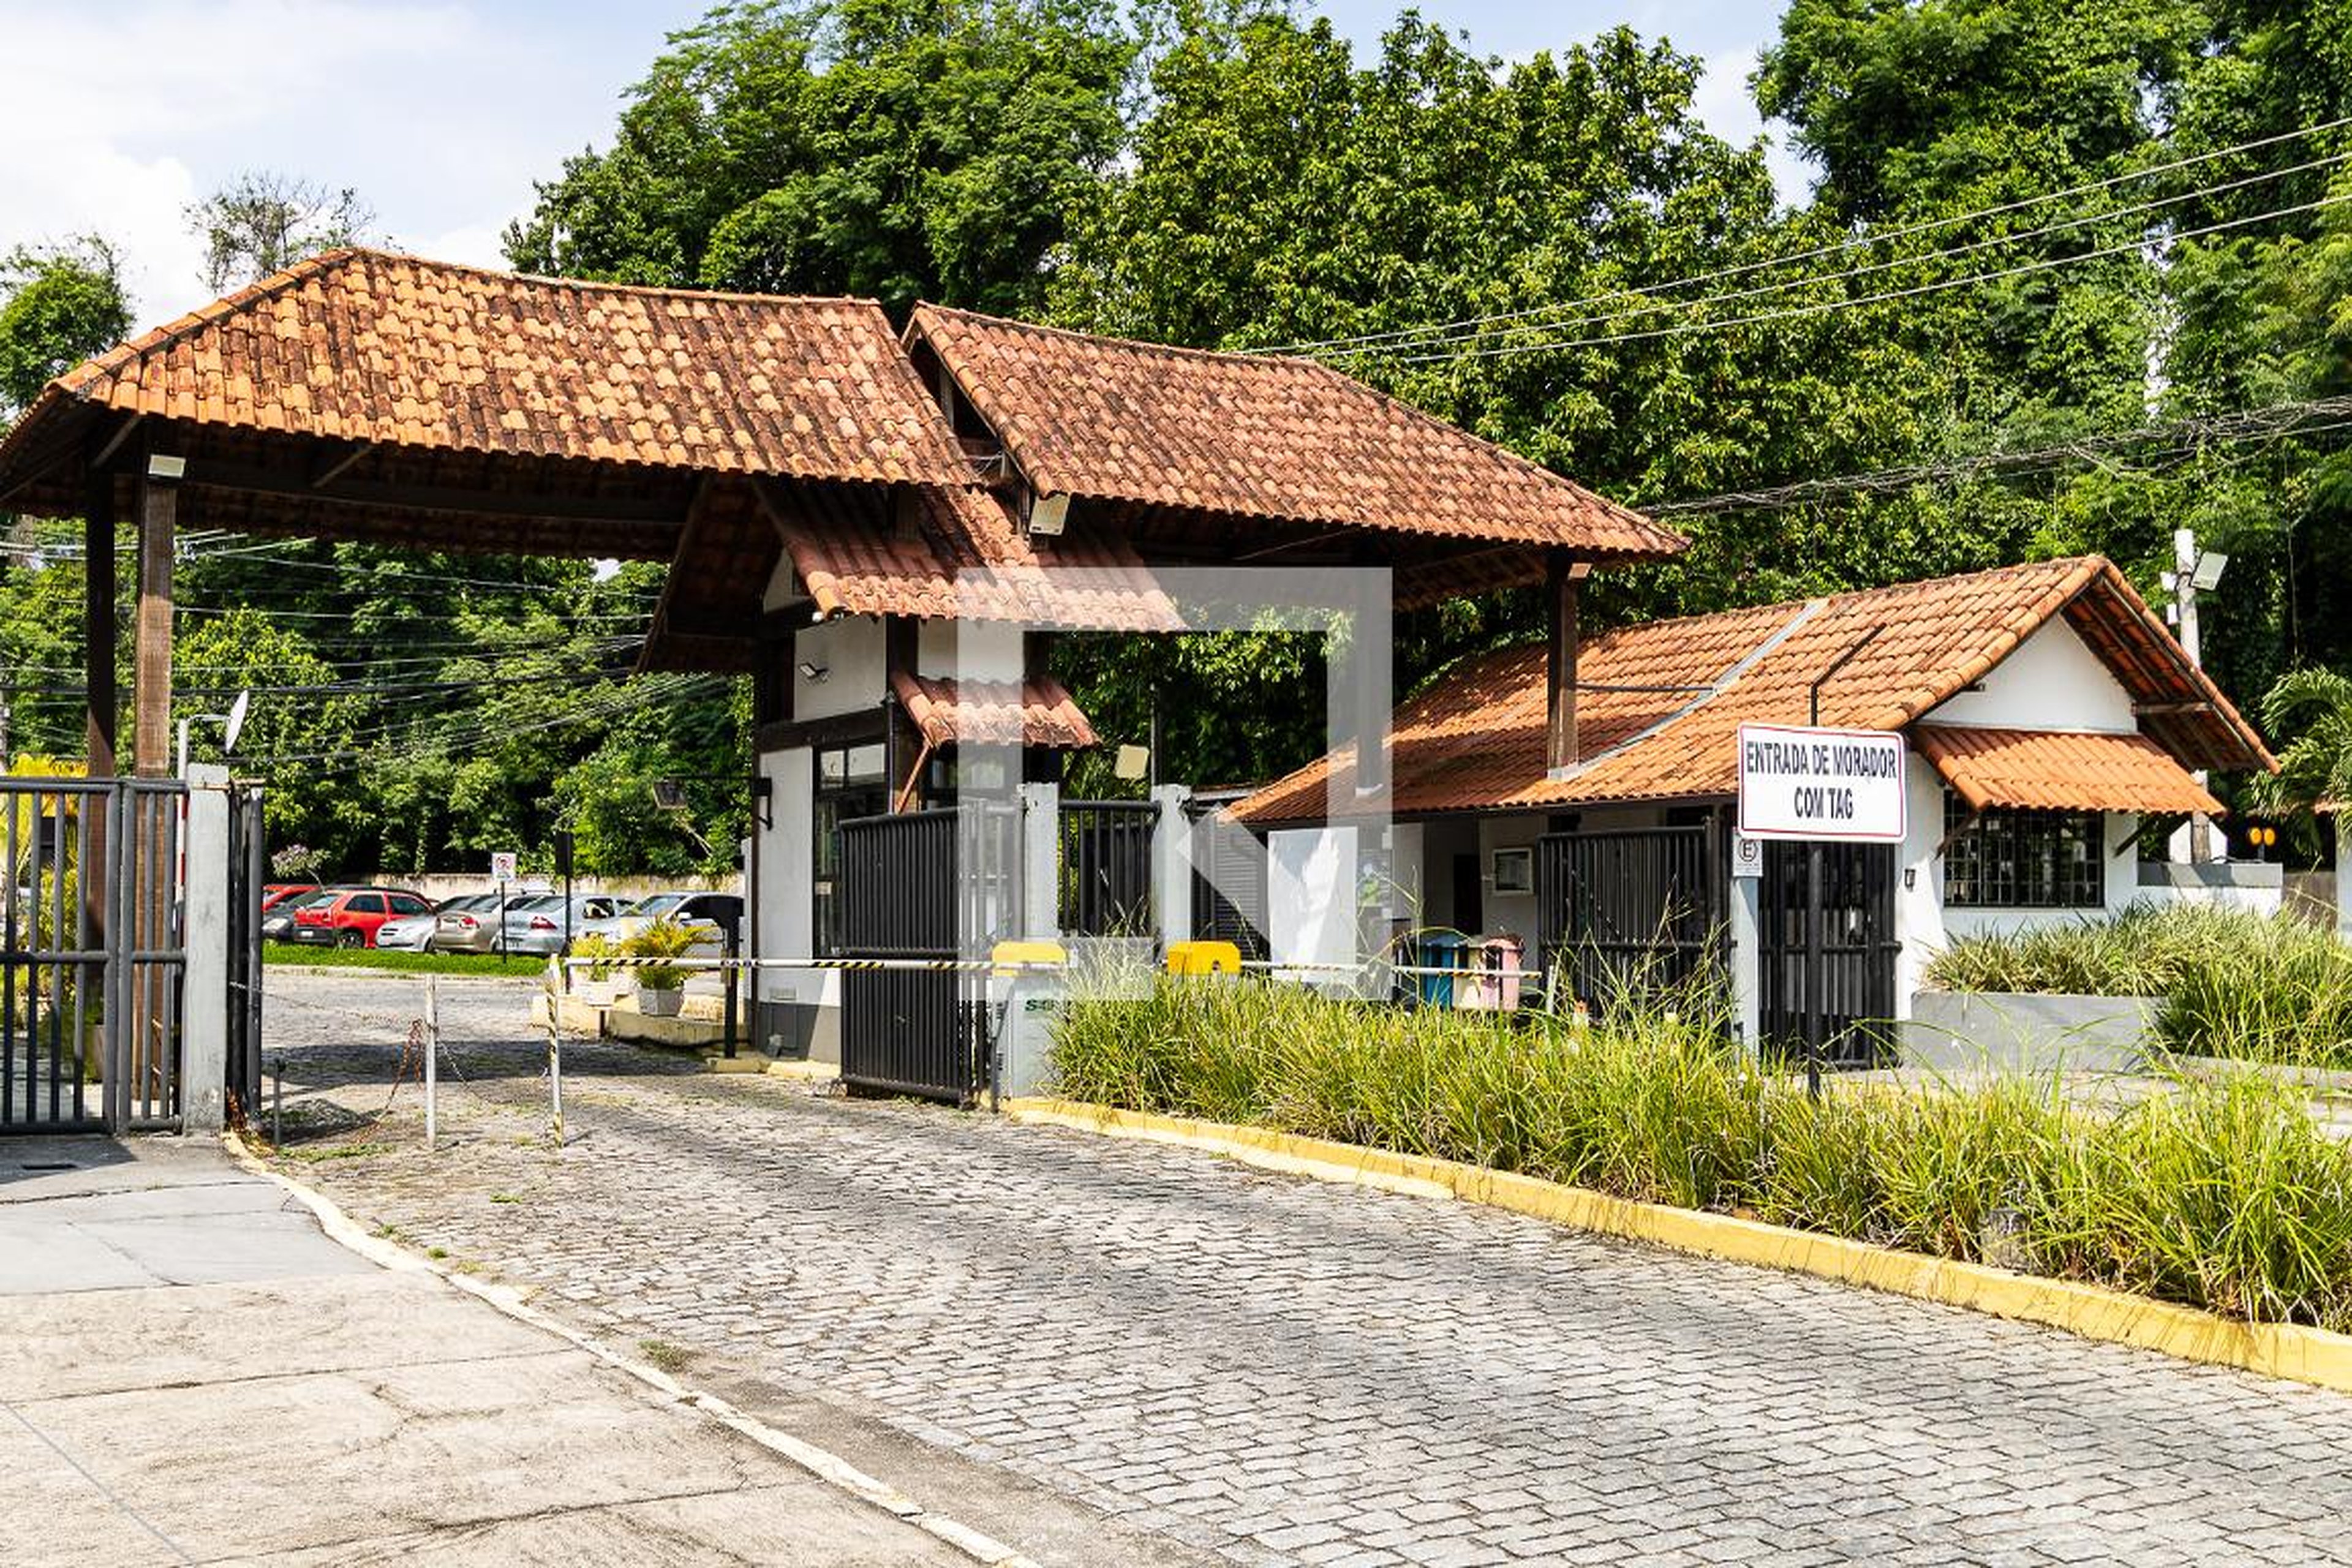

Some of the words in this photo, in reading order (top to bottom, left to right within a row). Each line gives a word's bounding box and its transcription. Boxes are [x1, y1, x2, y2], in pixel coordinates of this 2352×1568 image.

[1746, 741, 1809, 774] ENTRADA
[1812, 744, 1829, 775] DE
[1833, 745, 1897, 778] MORADOR
[1795, 786, 1823, 818] COM
[1828, 788, 1853, 819] TAG
